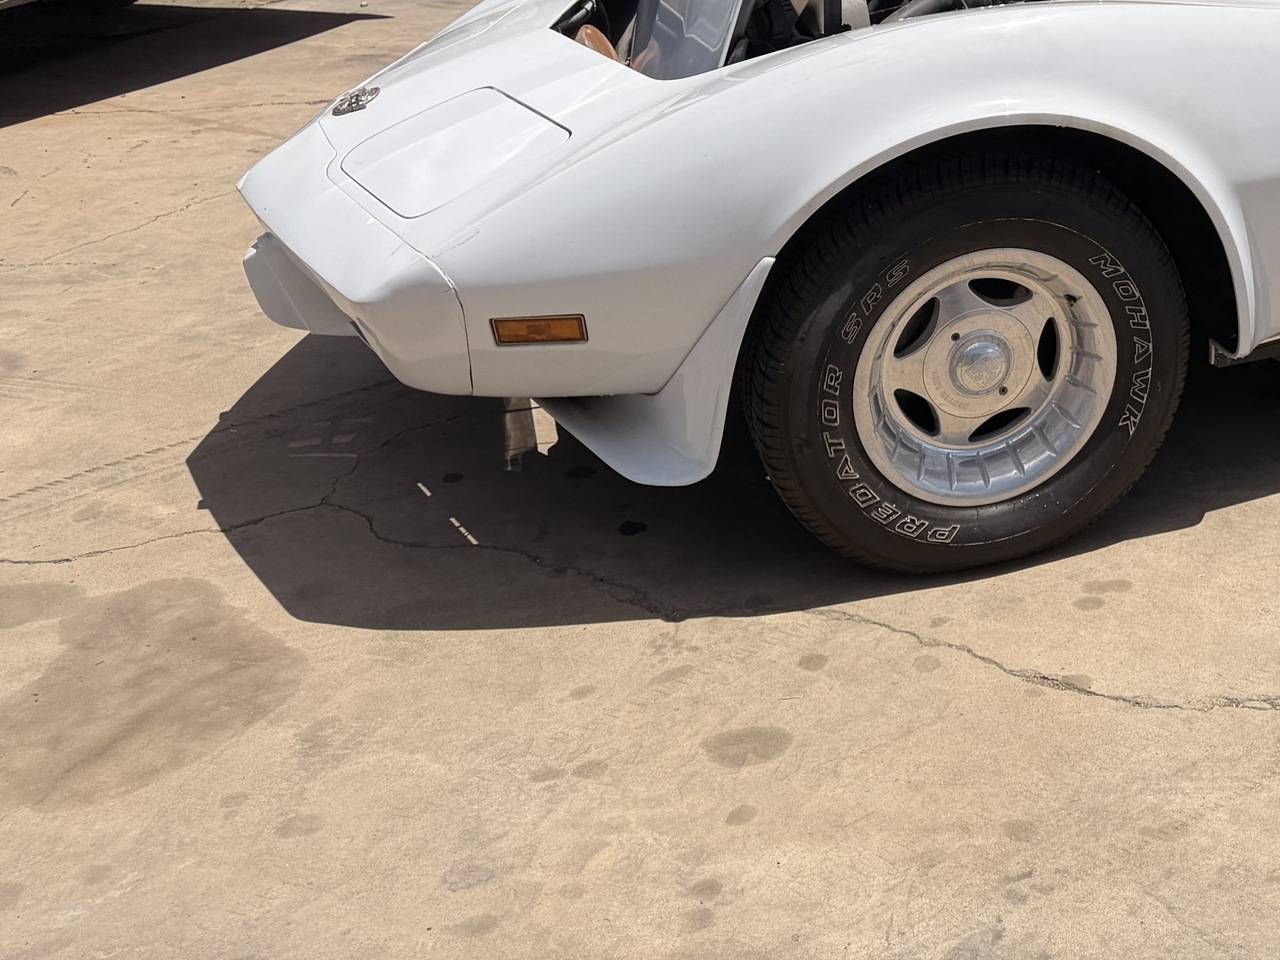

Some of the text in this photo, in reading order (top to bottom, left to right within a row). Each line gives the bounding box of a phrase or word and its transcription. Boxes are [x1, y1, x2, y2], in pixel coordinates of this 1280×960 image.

[822, 258, 960, 543] PREDATOR SRS
[1090, 252, 1153, 437] MOHAWK
